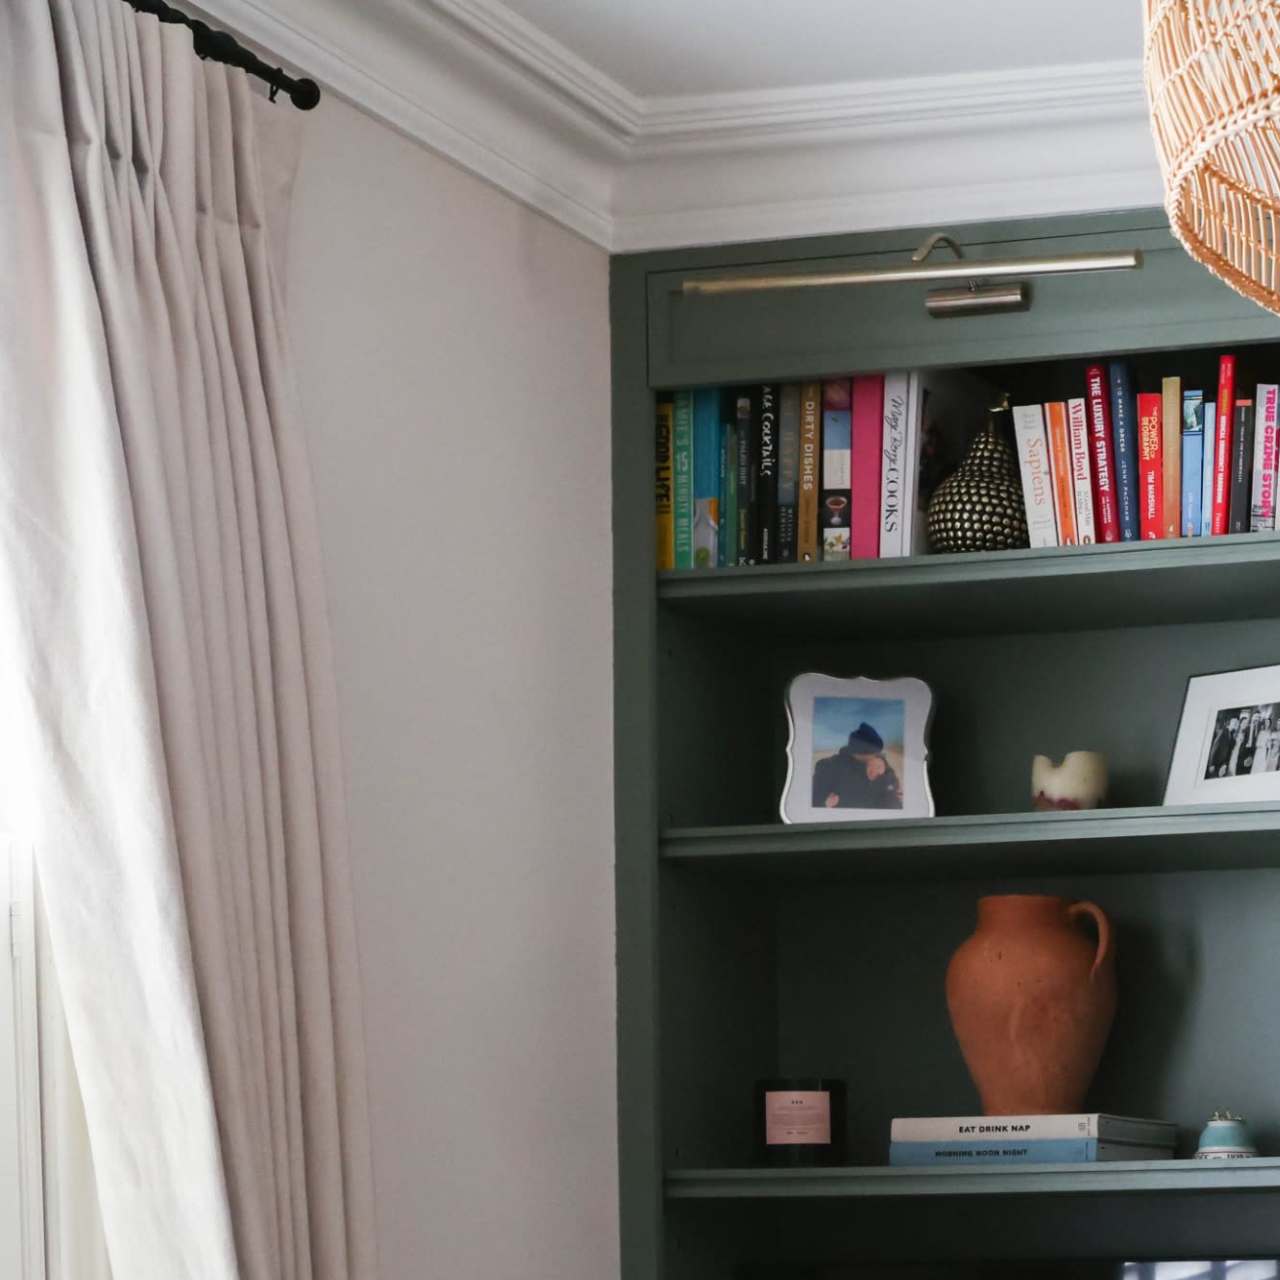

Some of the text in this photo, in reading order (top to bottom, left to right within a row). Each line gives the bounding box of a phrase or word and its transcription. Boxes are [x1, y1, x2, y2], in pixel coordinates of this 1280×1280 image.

[1091, 376, 1101, 397] THE
[802, 401, 816, 441] DIRTY
[884, 396, 905, 434] Mary
[1092, 398, 1105, 438] LUXURY
[1150, 417, 1160, 451] POWER
[1070, 402, 1088, 481] William Boyd
[1119, 431, 1127, 454] DRESS
[1141, 417, 1151, 462] GEOGRAPHY
[1260, 389, 1276, 519] TRUE CRIME STORY
[802, 444, 815, 492] DISHES
[1024, 436, 1046, 506] Sapiens
[1095, 440, 1110, 493] STRATEGY
[884, 467, 900, 534] COOKS
[1147, 470, 1155, 521] TIM MARSHALL
[958, 1124, 1031, 1134] EAT DRINK NAP
[935, 1148, 1028, 1157] MORNING NOON NIGHT
